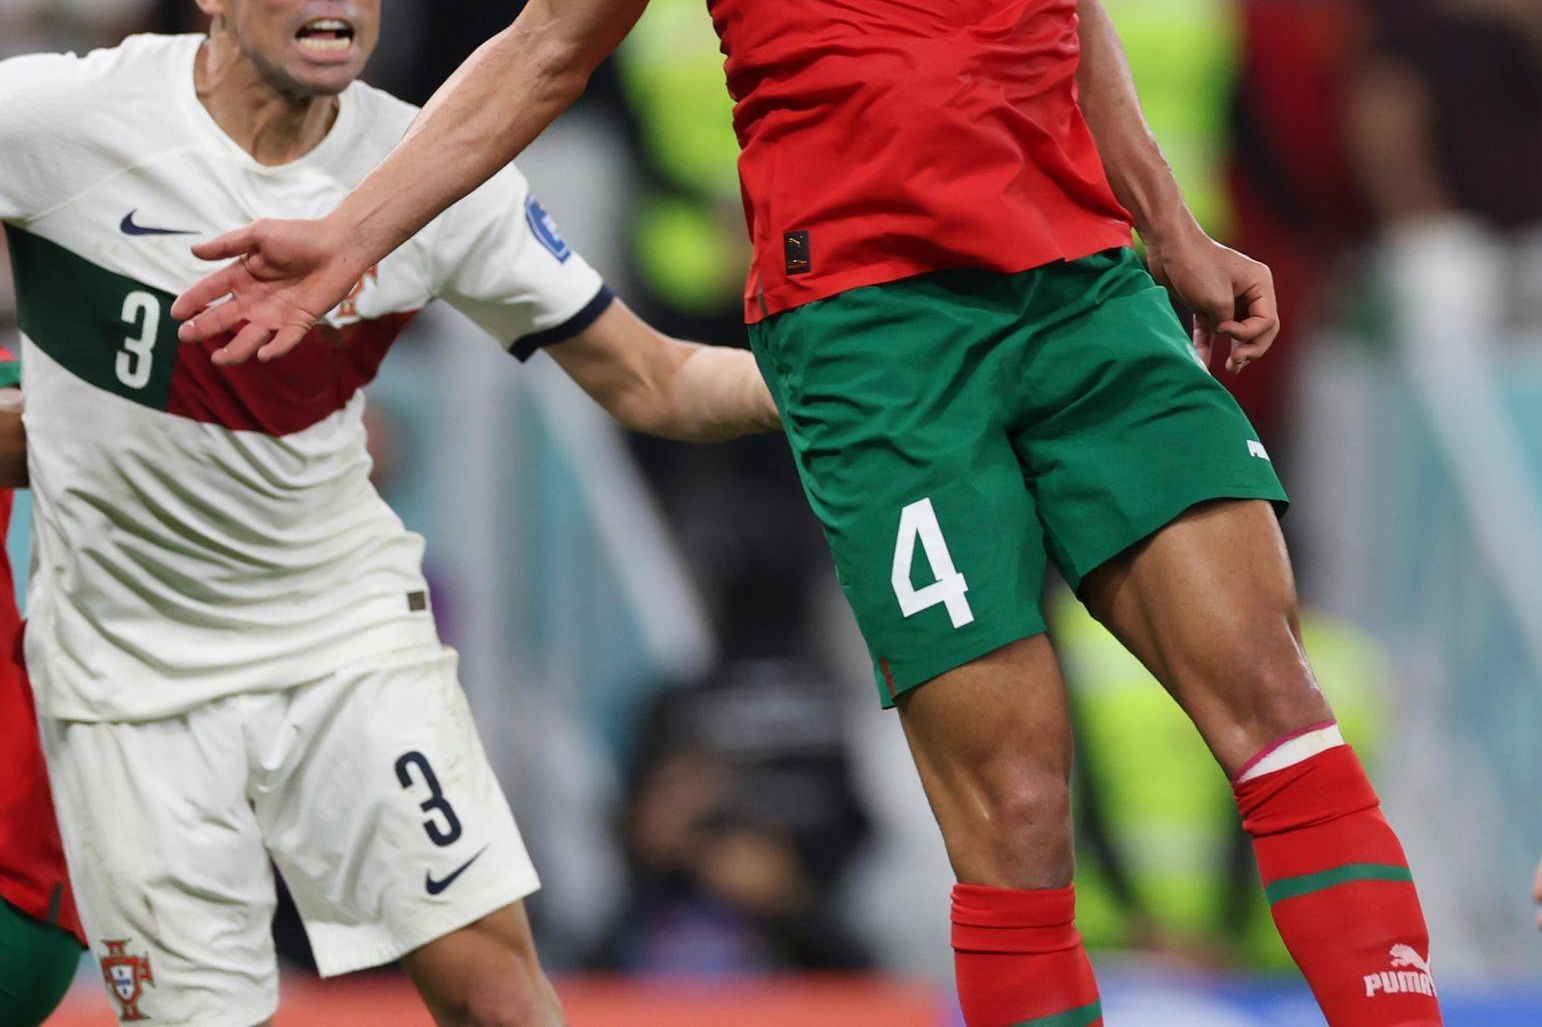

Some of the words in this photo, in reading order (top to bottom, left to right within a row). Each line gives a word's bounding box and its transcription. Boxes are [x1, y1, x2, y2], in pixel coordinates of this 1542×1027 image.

[115, 290, 160, 389] 3
[890, 497, 975, 629] 4
[395, 750, 462, 847] 3
[1363, 970, 1437, 998] PUMA
